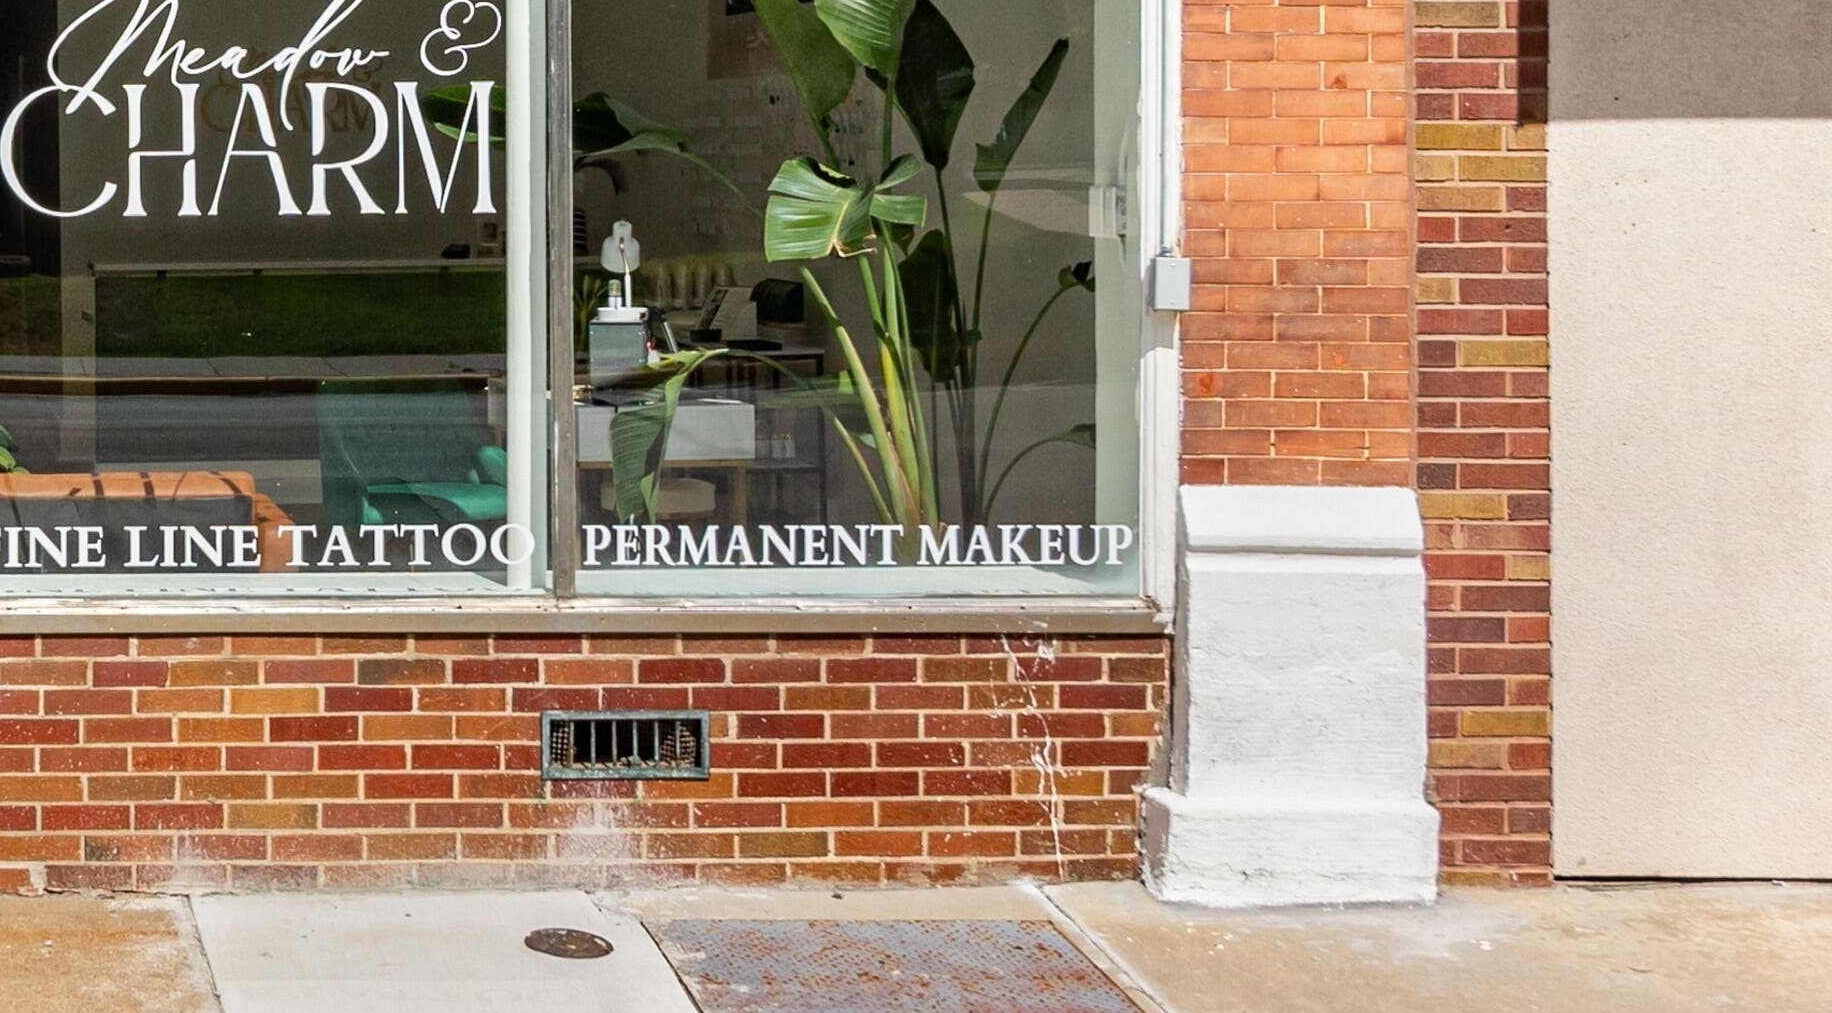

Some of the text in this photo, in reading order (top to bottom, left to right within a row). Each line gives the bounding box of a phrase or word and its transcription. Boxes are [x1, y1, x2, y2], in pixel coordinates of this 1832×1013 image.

[123, 524, 262, 568] LINE
[277, 522, 536, 567] TATTOO
[581, 523, 1134, 567] PERMANENT MAKEUP
